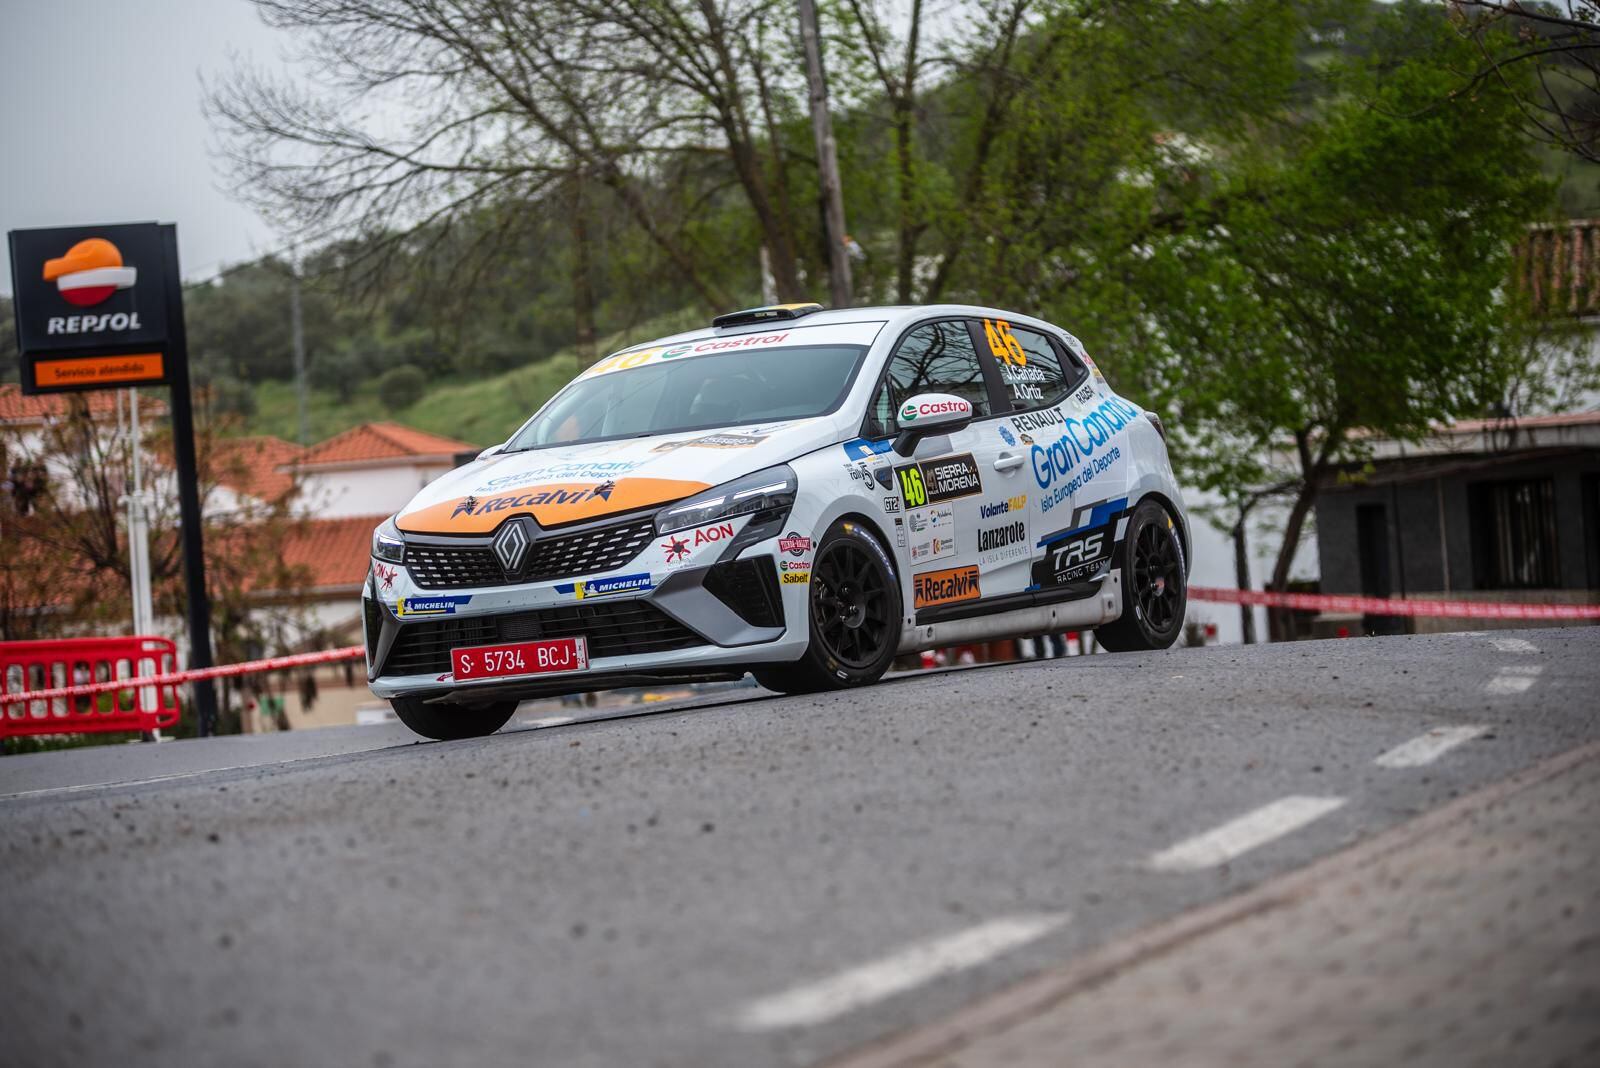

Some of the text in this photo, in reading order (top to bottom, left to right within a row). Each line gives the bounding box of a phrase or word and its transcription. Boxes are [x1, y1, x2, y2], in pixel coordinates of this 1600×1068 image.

[47, 312, 141, 335] REPSOL
[694, 333, 789, 353] Castrol
[983, 317, 1027, 366] 46
[1012, 383, 1044, 400] A.Ortiz
[919, 401, 969, 415] Castrol
[1010, 407, 1067, 433] RENAULT
[934, 462, 971, 481] SIERRA
[1030, 434, 1081, 490] Gran
[900, 467, 925, 507] 46
[938, 473, 980, 493] MORENA
[1040, 446, 1121, 514] Isla Europea del Deporte
[474, 488, 591, 516] Recalvi
[695, 523, 734, 547] AON
[977, 520, 1025, 553] Lanzarote
[1053, 532, 1104, 570] TRS
[598, 579, 650, 592] MICHELIN
[783, 573, 808, 584] Sabelt
[924, 571, 968, 602] Recalvi
[1056, 568, 1084, 584] RACING
[413, 601, 455, 610] MICHELIN
[484, 649, 526, 672] 5734
[537, 645, 570, 667] BCJ
